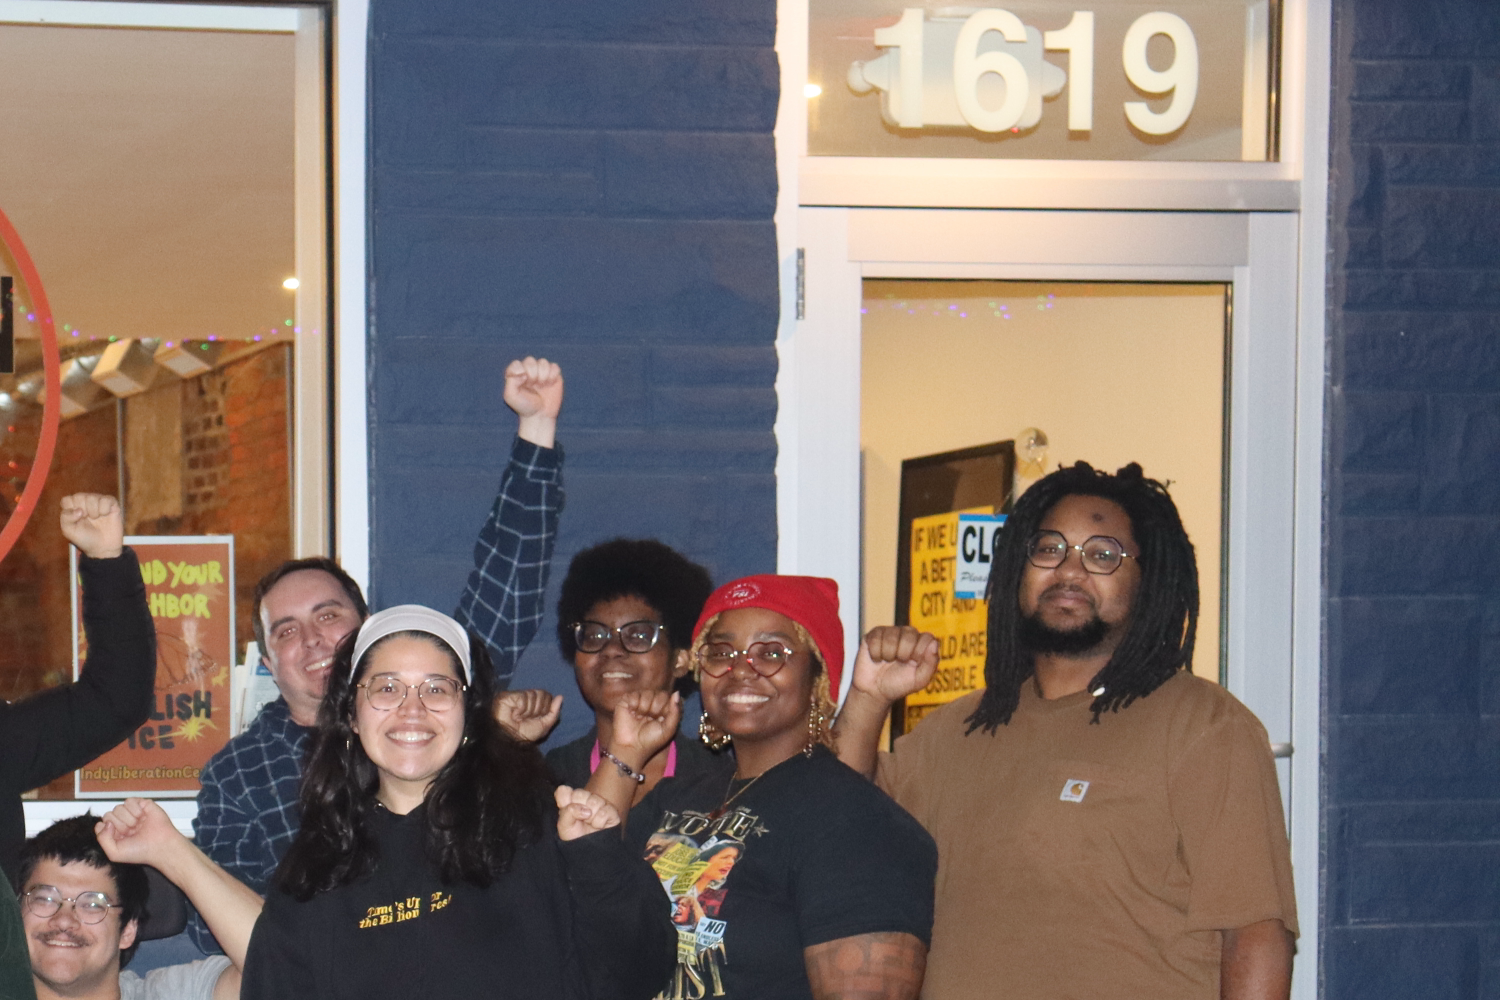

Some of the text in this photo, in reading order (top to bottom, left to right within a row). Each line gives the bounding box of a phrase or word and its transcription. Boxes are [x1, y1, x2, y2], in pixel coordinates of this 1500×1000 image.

[874, 8, 1199, 136] 1619
[927, 524, 947, 550] WE
[167, 560, 224, 589] YOUR
[920, 562, 929, 585] A
[147, 592, 211, 619] HBOR
[921, 591, 947, 617] CITY
[961, 631, 985, 657] ARE
[916, 665, 977, 695] OSSIBLE
[127, 724, 176, 750] ICE
[657, 810, 760, 841] VOTE
[359, 916, 378, 929] the
[704, 920, 726, 935] NO
